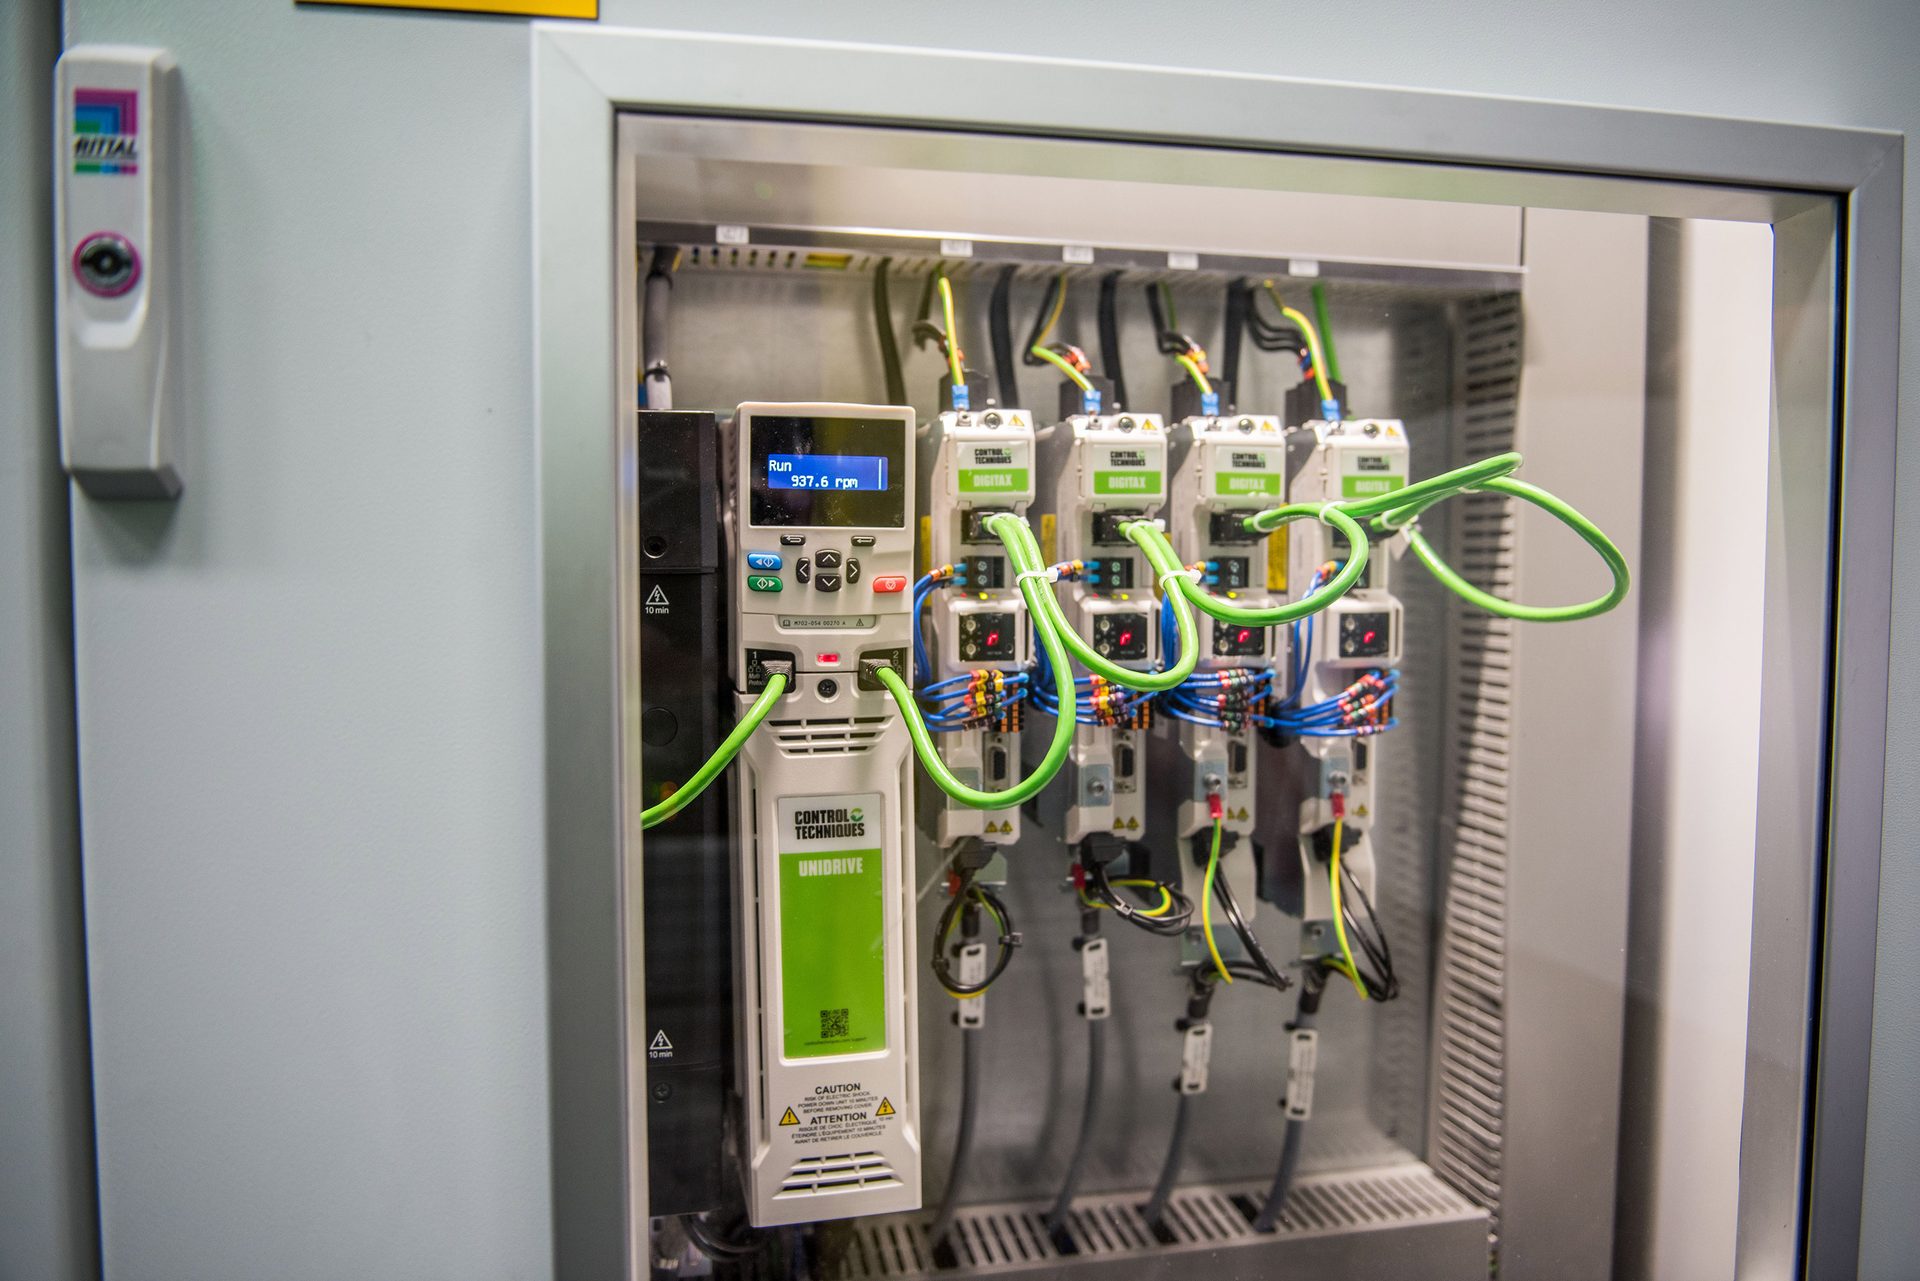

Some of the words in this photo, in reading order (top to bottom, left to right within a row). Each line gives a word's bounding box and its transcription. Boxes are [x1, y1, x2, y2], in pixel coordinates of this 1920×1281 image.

[75, 138, 137, 158] RITTAL
[769, 460, 792, 472] Run
[791, 475, 829, 487] 937.6
[835, 477, 858, 489] rpm
[974, 474, 1013, 487] DIGITAX
[645, 606, 654, 614] 10
[655, 606, 669, 614] min
[893, 651, 899, 659] 2
[794, 809, 849, 825] CONTROL
[795, 823, 865, 840] TECHNIQUES
[799, 857, 863, 877] UNIDRIVE
[659, 1050, 673, 1058] min
[815, 1083, 861, 1095] CAUTION
[810, 1112, 867, 1125] ATTENTION
